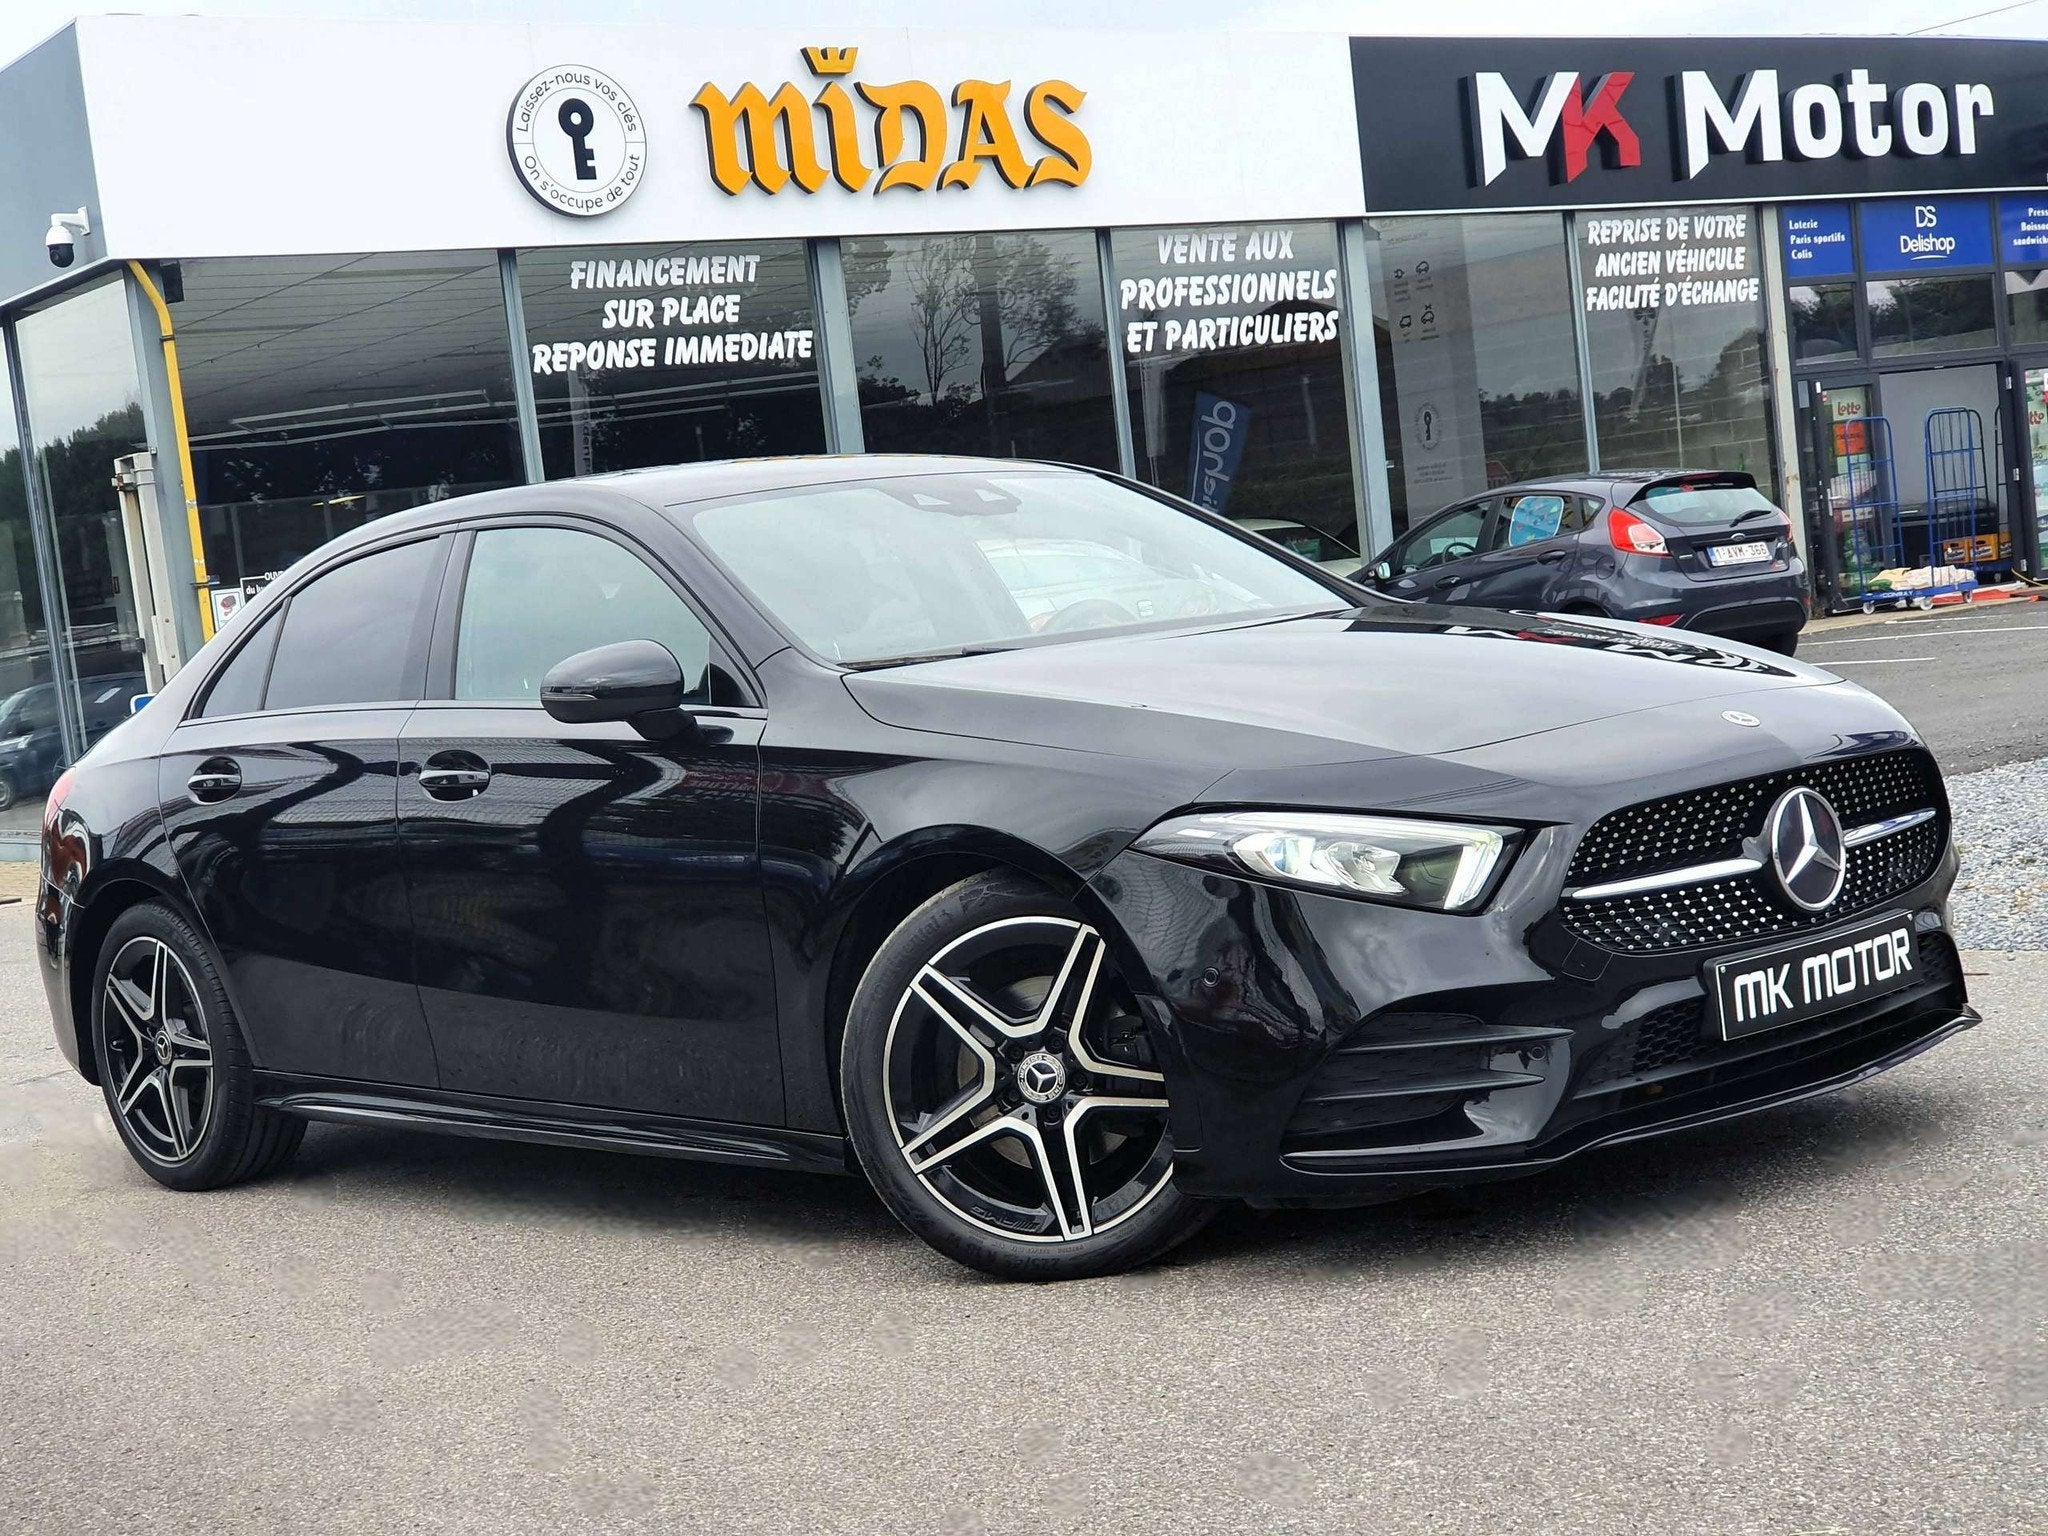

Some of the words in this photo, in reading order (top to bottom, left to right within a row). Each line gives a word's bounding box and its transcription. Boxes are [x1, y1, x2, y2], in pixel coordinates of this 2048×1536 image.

[516, 72, 591, 133] Laissez-nous
[594, 78, 618, 101] vos
[617, 101, 637, 132] clés
[1474, 71, 1642, 187] MK
[1681, 69, 1995, 180] Motor
[524, 155, 540, 181] On
[540, 180, 603, 213] s'occupe
[606, 186, 623, 203] de
[620, 154, 640, 186] tout
[1587, 217, 1661, 247] REPRISE
[1665, 216, 1690, 241] DE
[1693, 214, 1747, 240] VOTRE
[1789, 219, 1818, 230] Loterie
[1915, 205, 1937, 228] DS
[1157, 232, 1238, 265] VENTE
[1245, 230, 1294, 261] AUX
[1790, 234, 1812, 245] Paris
[1813, 232, 1846, 245] sportifs
[1791, 249, 1813, 260] Colis
[1900, 234, 1955, 254] Delishop
[570, 254, 760, 290] FINANCEMENT
[1595, 250, 1661, 277] ANCIEN
[1665, 243, 1746, 273] VÉHICULE
[1120, 269, 1338, 311] PROFESSIONNELS
[1586, 277, 1661, 311] FACILITÉ
[1664, 275, 1760, 307] D'ÉCHANGE
[602, 298, 655, 329] SUR
[662, 294, 740, 326] PLACE
[1126, 321, 1158, 353] ET
[1164, 310, 1339, 351] PARTICULIERS
[532, 338, 657, 375] REPONSE
[664, 330, 814, 366] IMMEDIATE
[1734, 963, 1794, 1022] MK
[1802, 927, 1913, 1004] MOTOR
